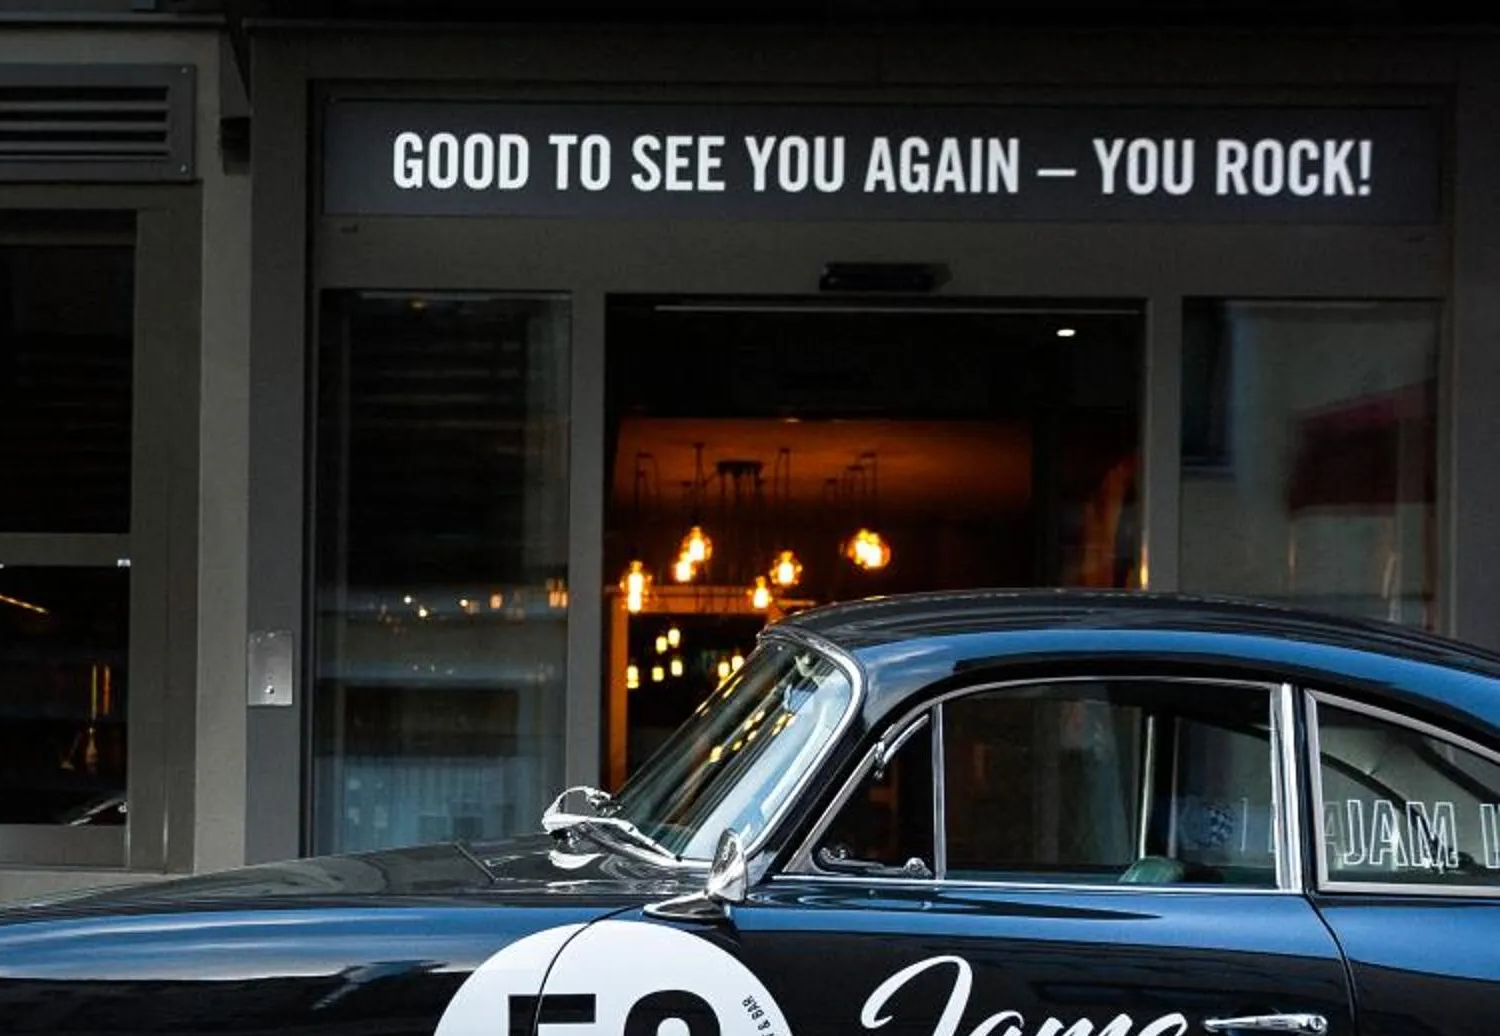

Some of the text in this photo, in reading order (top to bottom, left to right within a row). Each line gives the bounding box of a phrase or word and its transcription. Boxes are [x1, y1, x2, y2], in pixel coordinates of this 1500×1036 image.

[393, 131, 530, 190] GOOD
[548, 134, 611, 191] TO
[631, 134, 726, 192] SEE
[744, 135, 845, 193] YOU
[863, 136, 1019, 193] AGAIN
[1093, 138, 1194, 195] YOU
[1216, 138, 1372, 196] ROCK!
[1343, 800, 1459, 869] JAM
[742, 995, 764, 1020] BAR
